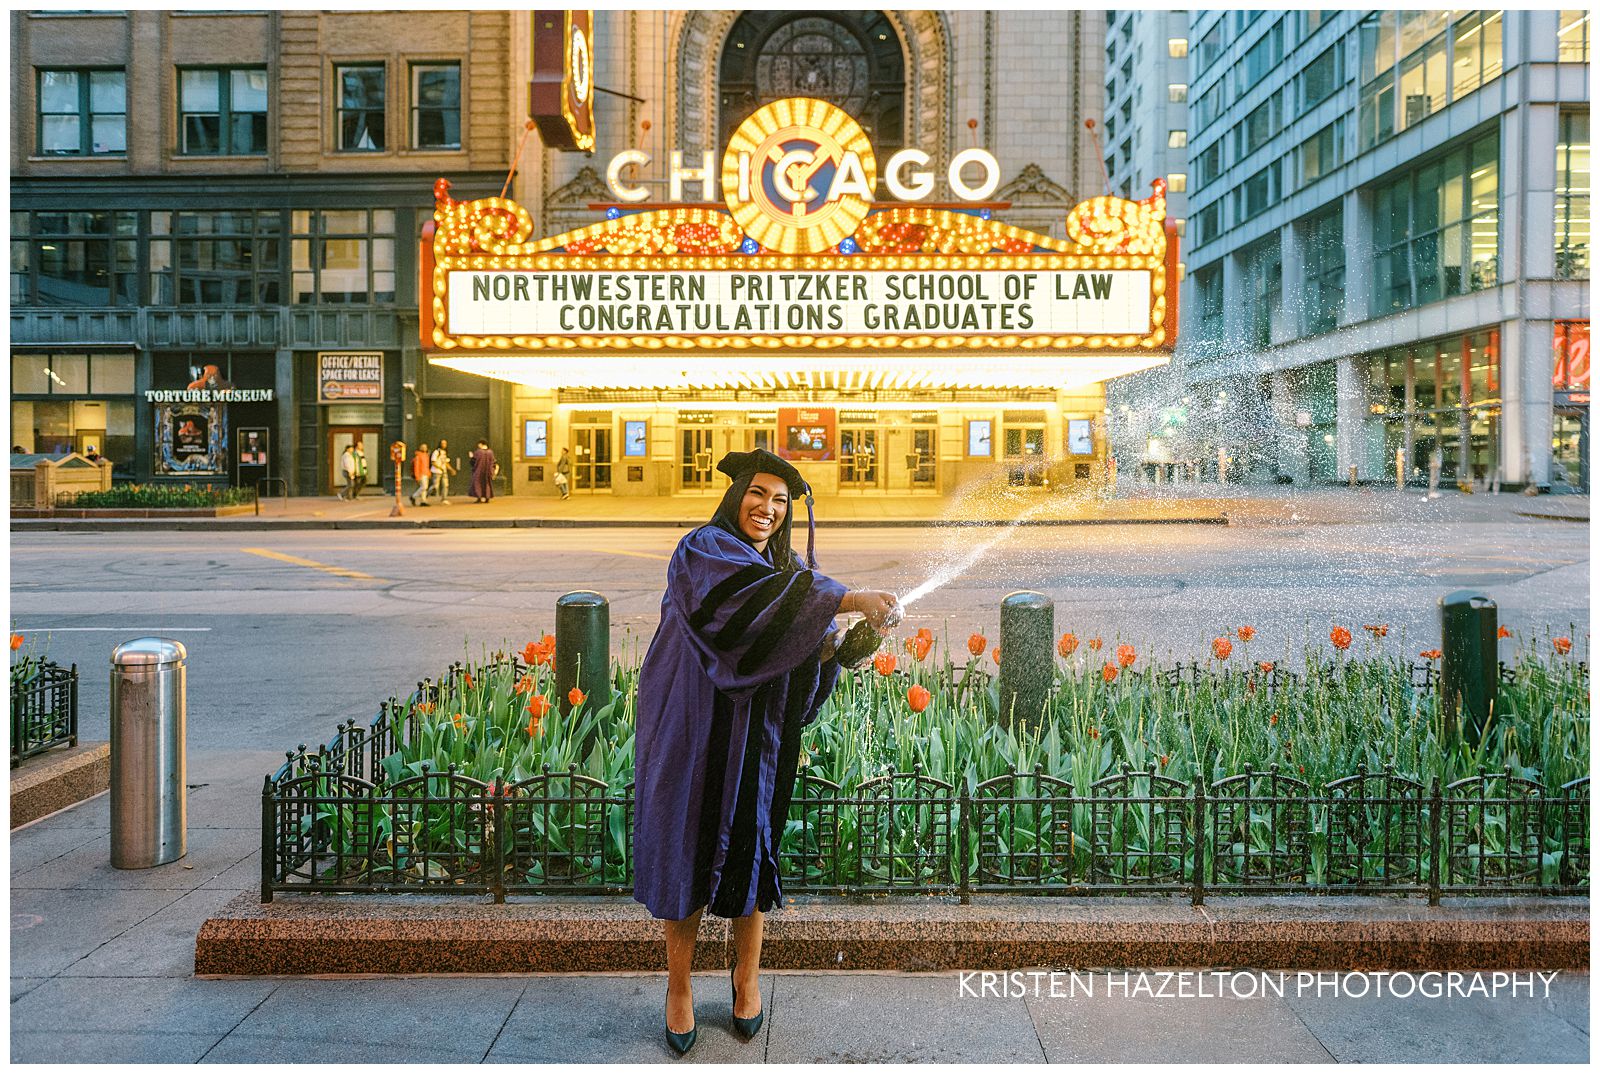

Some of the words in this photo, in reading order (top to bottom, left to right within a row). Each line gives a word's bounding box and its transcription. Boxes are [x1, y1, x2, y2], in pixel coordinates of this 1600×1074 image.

[605, 148, 1001, 202] CHICAGO
[472, 274, 705, 301] NORTHWESTERN
[730, 274, 868, 301] PRITZKER
[884, 273, 989, 300] SCHOOL
[1003, 273, 1038, 300] OF
[1055, 273, 1113, 300] LAW
[559, 303, 844, 331] CONGRATULATIONS
[863, 303, 1034, 330] GRADUATES
[322, 356, 380, 369] OFFICE/RETAIL
[322, 369, 343, 381] SPACE
[343, 369, 358, 381] FOR
[358, 369, 380, 381] LEASE
[144, 389, 211, 403] TORTURE
[212, 389, 273, 402] MUSEUM
